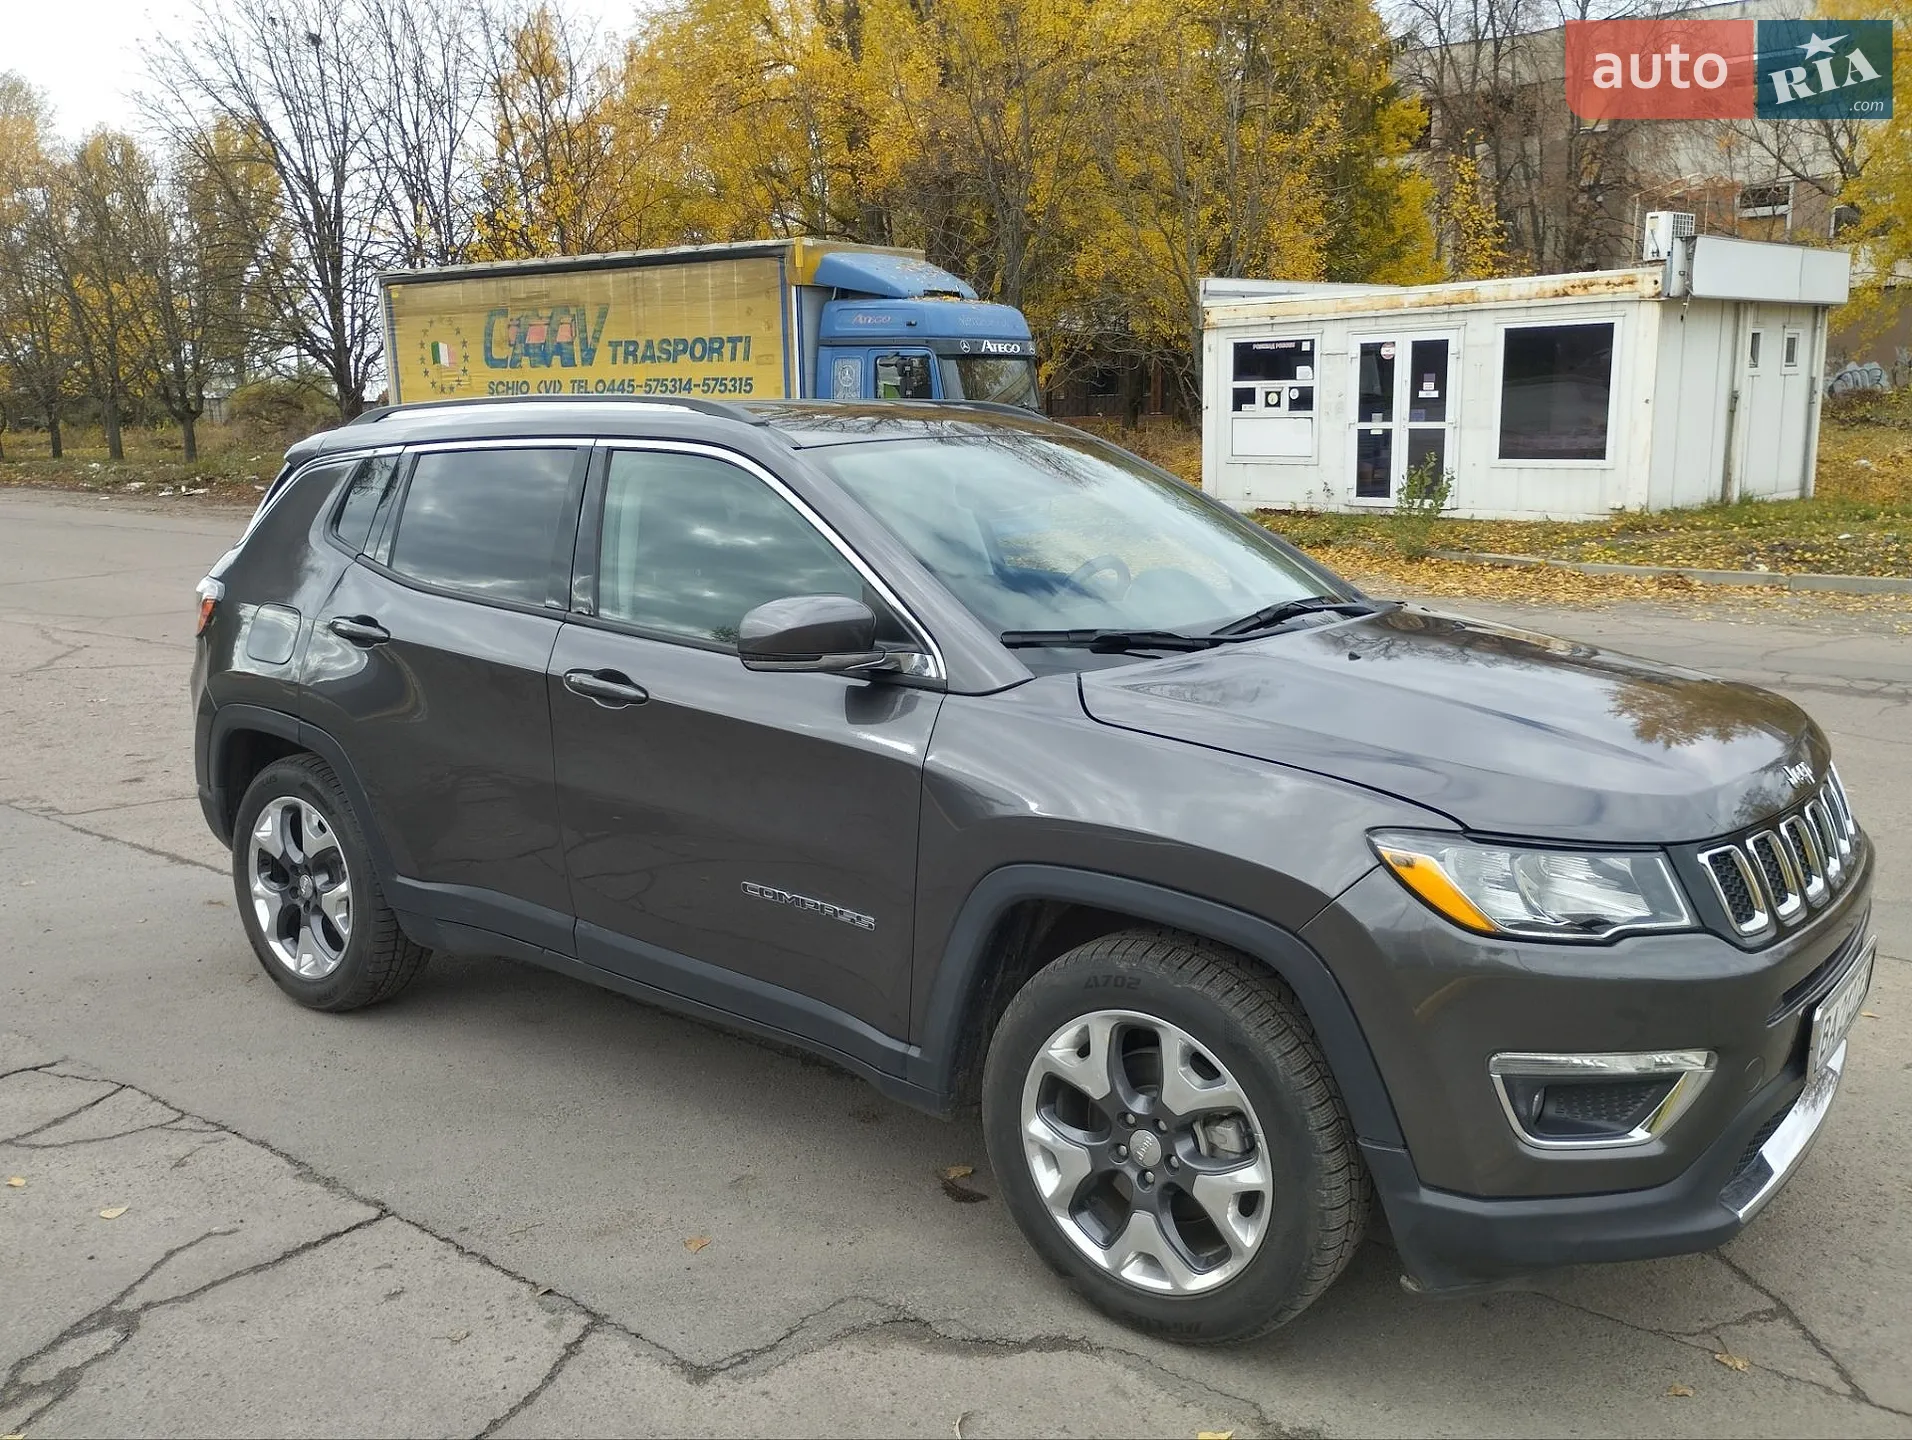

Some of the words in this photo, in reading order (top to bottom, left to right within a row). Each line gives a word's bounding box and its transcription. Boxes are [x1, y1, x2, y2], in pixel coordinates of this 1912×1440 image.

[608, 336, 752, 365] TRASPORTI
[488, 380, 530, 395] SCHIO
[741, 881, 876, 931] COMPASS
